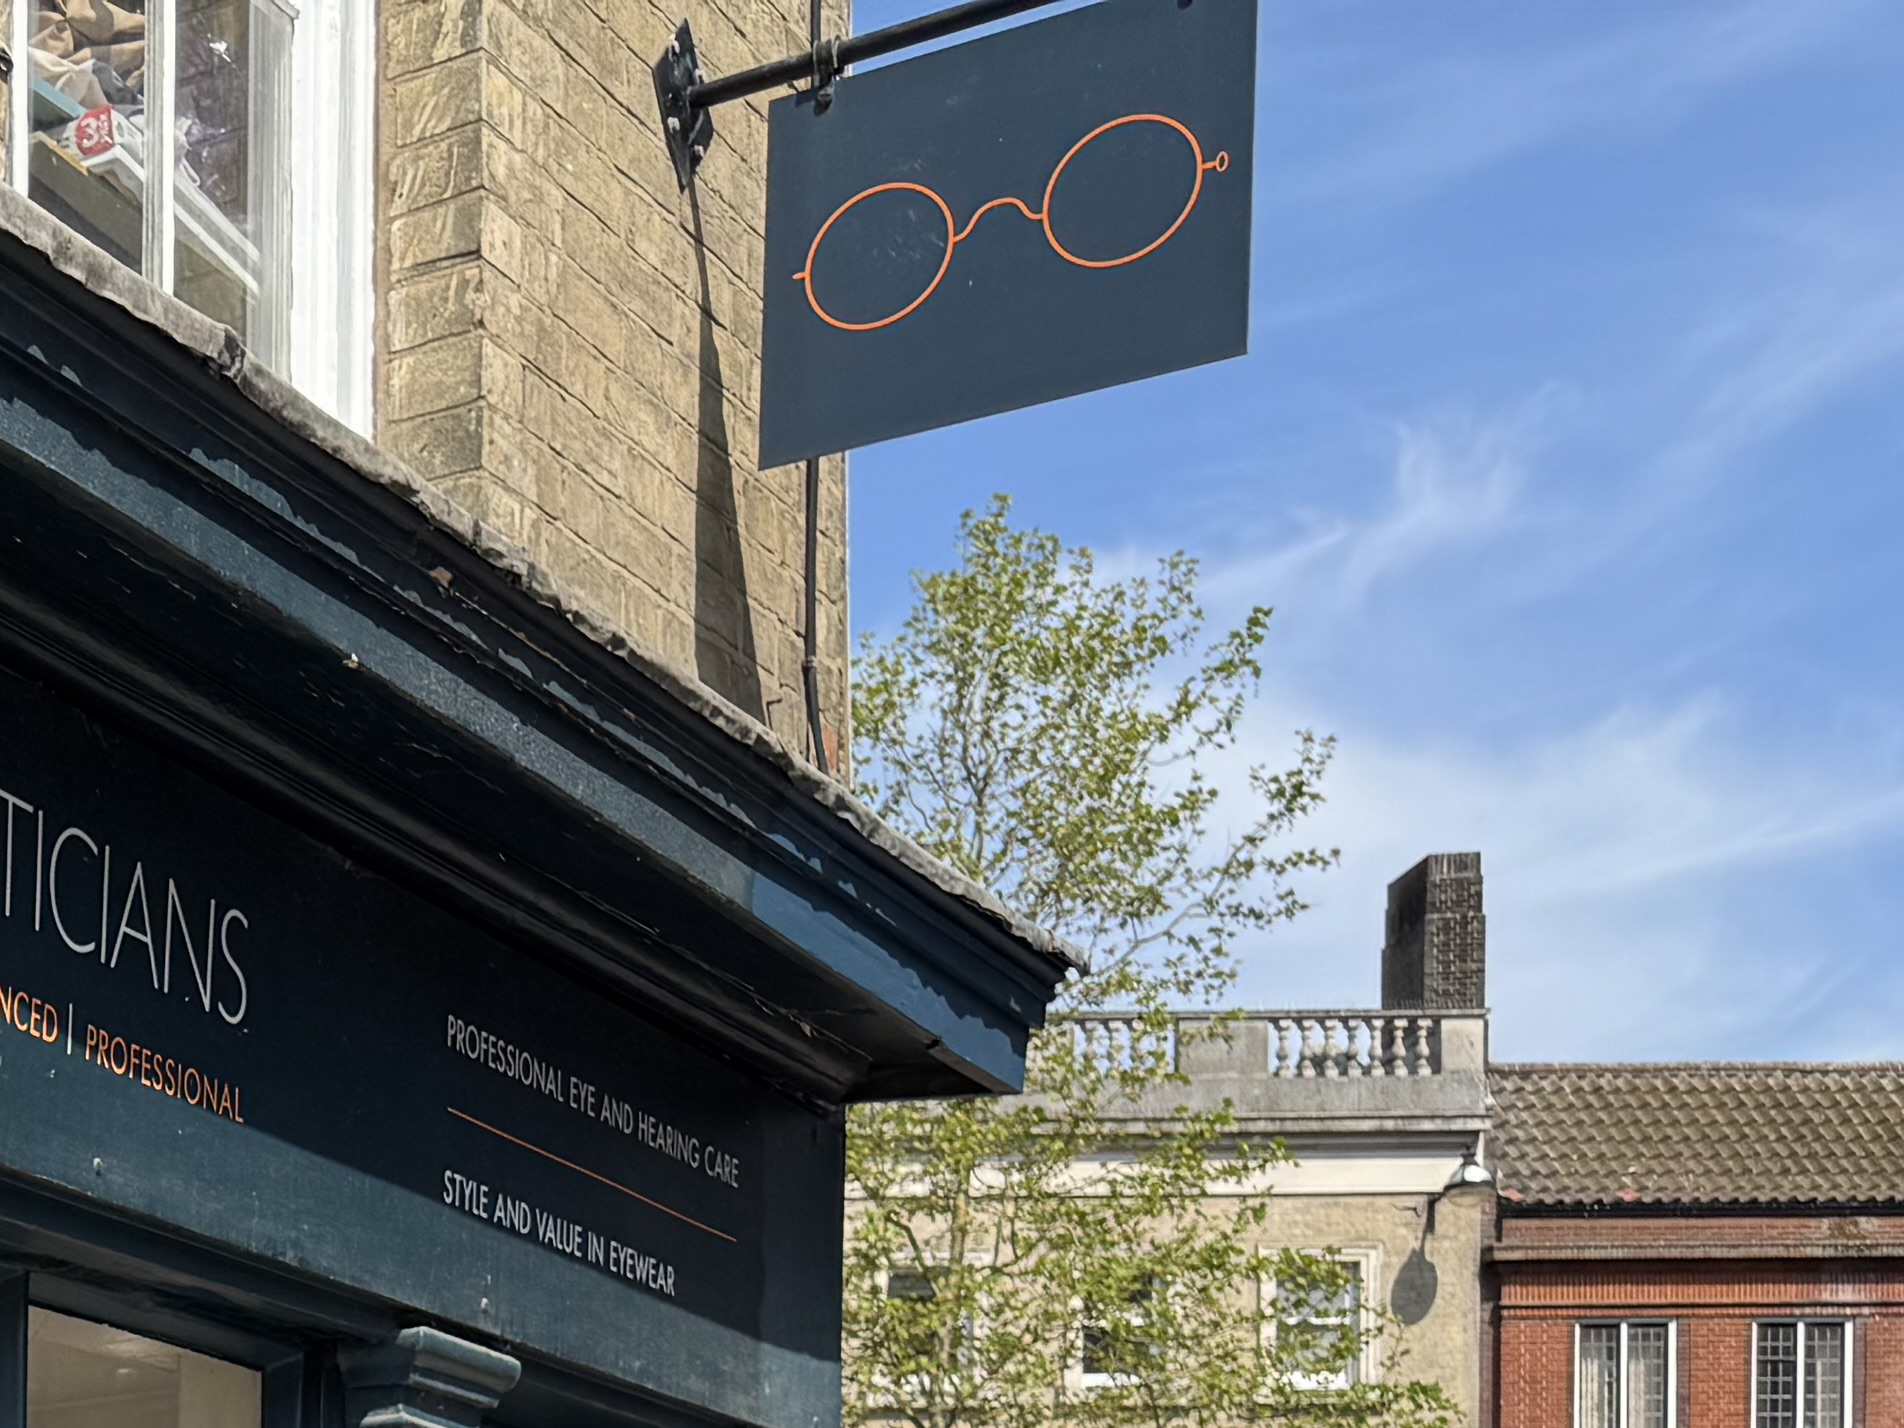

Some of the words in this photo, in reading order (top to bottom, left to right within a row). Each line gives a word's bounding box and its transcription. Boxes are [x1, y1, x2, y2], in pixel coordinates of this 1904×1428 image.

[85, 1024, 244, 1124] PROFESSIONAL
[447, 1014, 564, 1103] PROFESSIONAL
[569, 1077, 596, 1117] EYE
[600, 1094, 634, 1135] AND
[638, 1111, 700, 1168] HEARING
[704, 1145, 740, 1188] CARE
[443, 1169, 489, 1219] STYLE
[493, 1193, 531, 1235] AND
[535, 1208, 583, 1258] VALUE
[587, 1230, 605, 1267] IN
[609, 1240, 676, 1297] EYEWEAR
